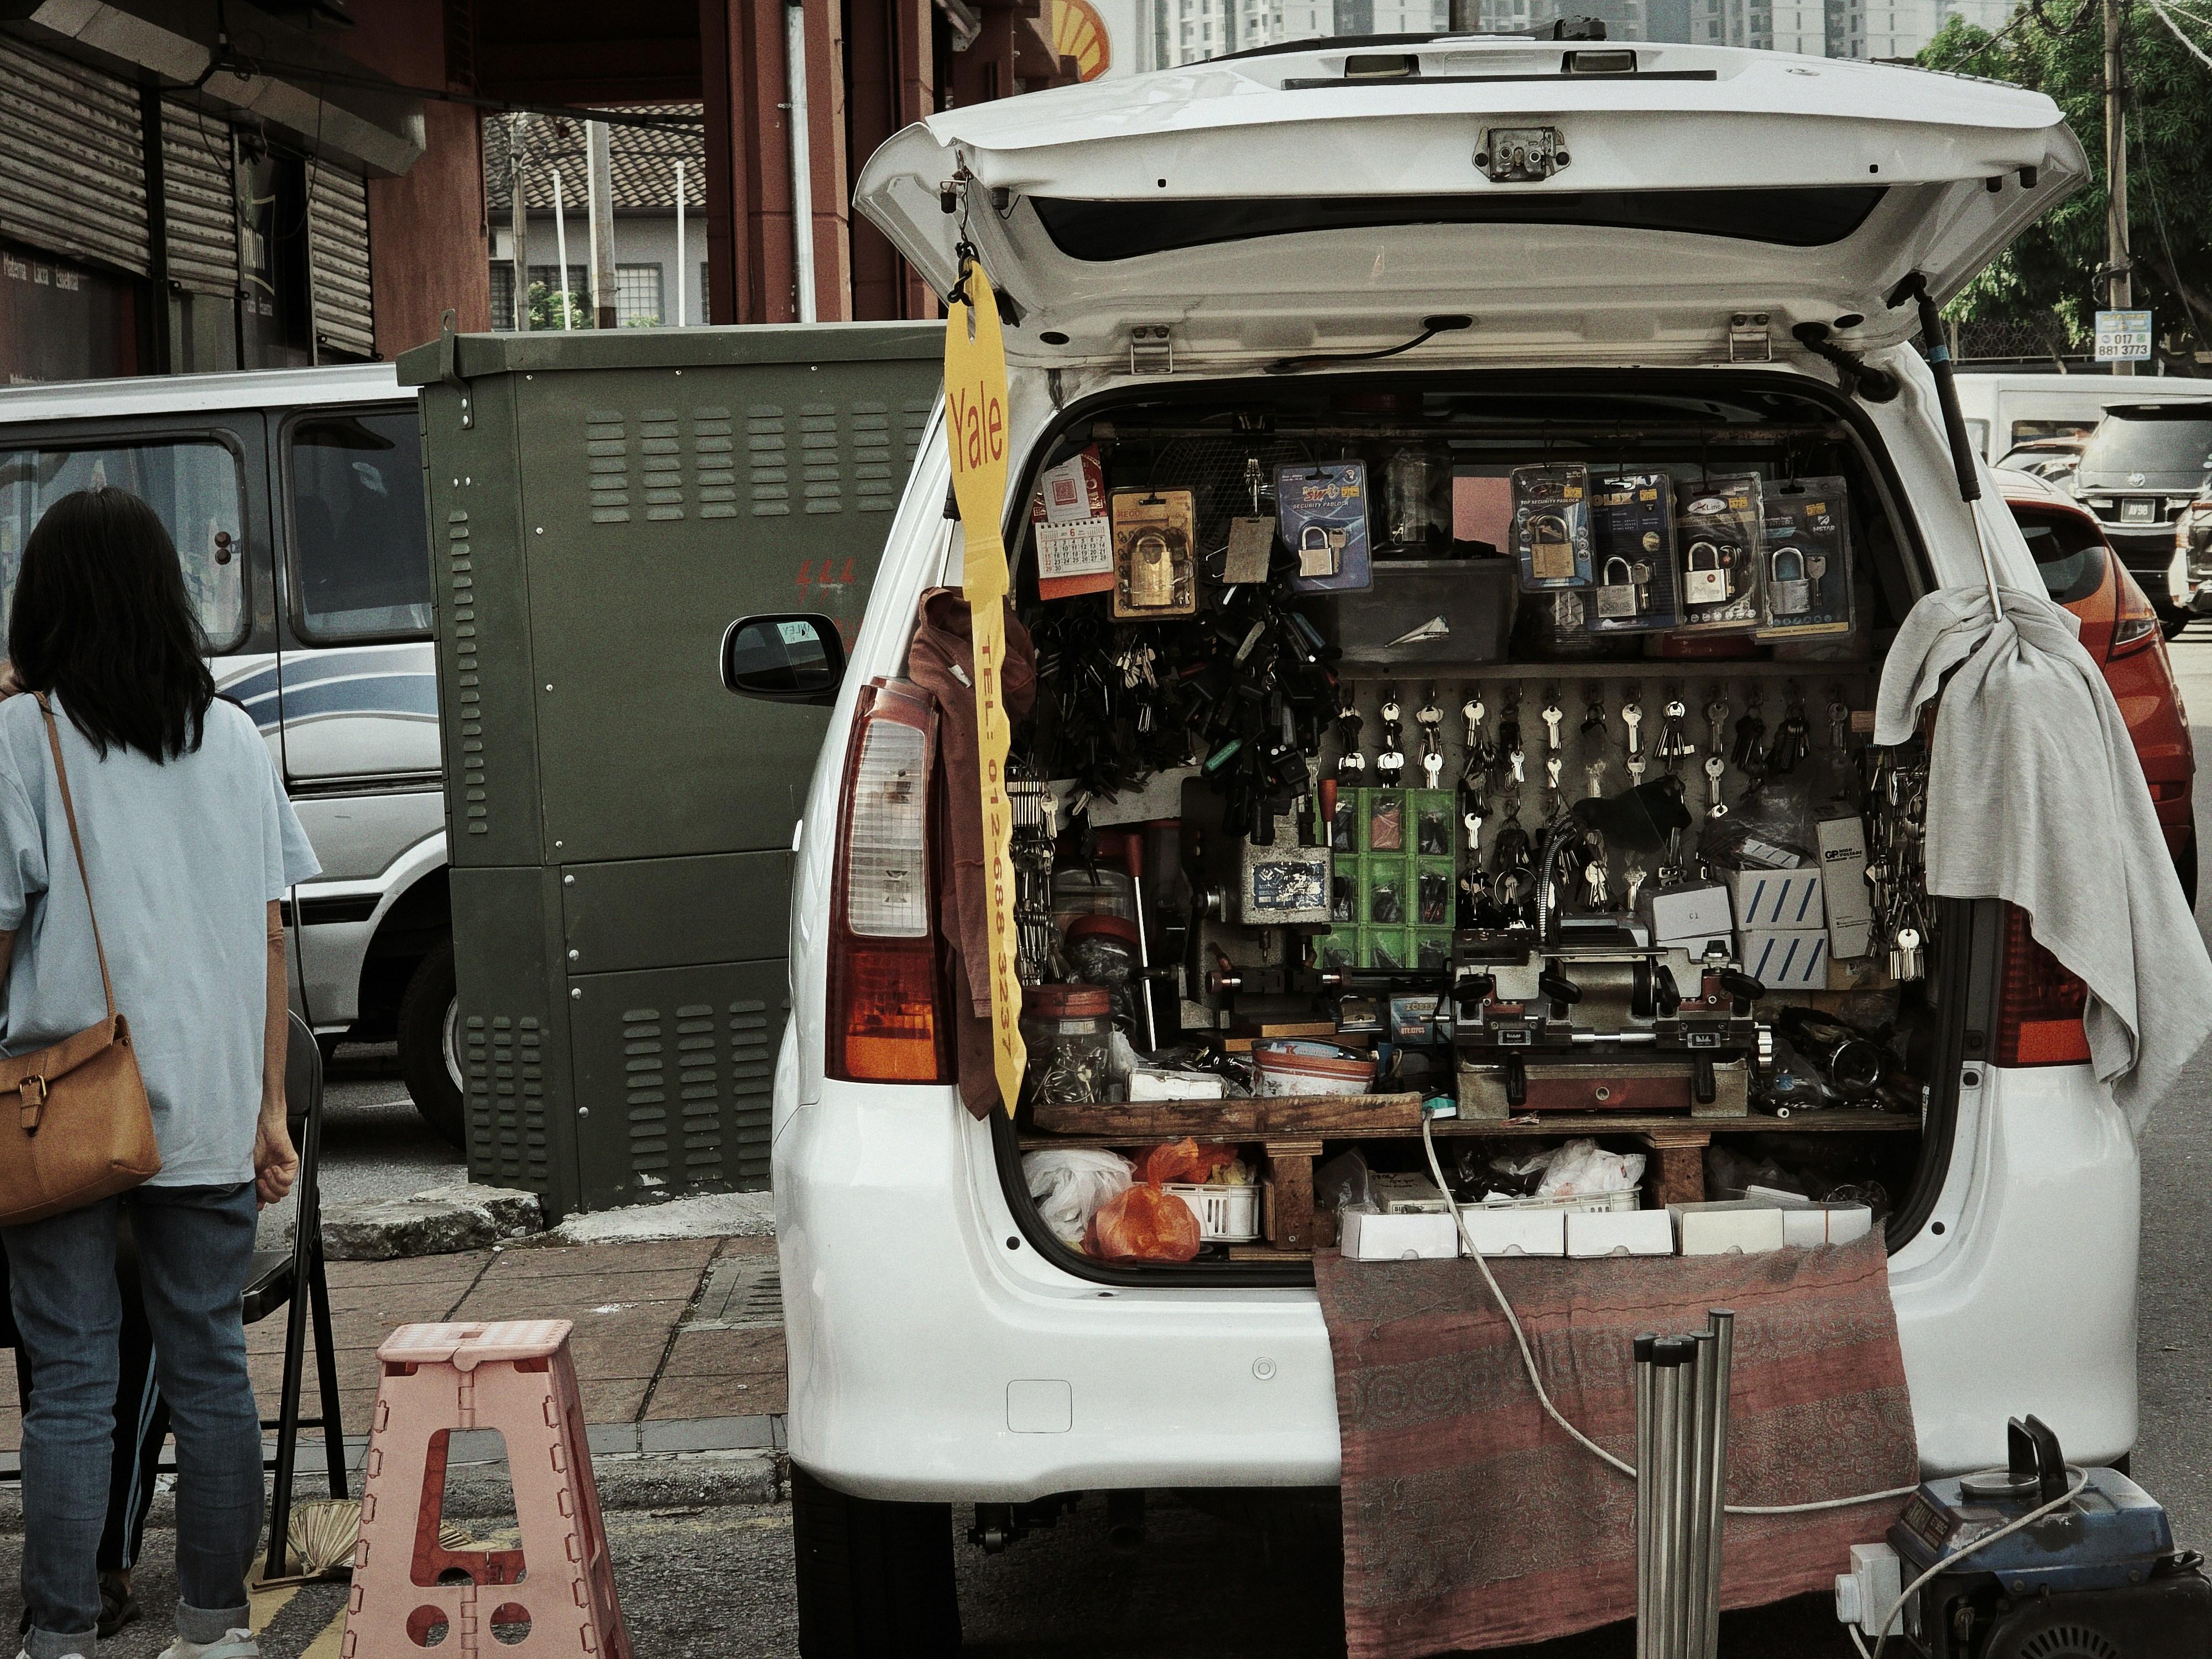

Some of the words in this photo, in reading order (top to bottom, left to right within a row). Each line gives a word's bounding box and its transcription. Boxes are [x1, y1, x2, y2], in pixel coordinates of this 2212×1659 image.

[2115, 335, 2132, 344] 017
[2099, 346, 2118, 356] 881
[2121, 345, 2147, 355] 3773
[950, 380, 1002, 473] Yale
[1070, 528, 1076, 537] 6
[982, 634, 994, 740] TEL:
[988, 758, 1005, 936] 012-688
[998, 951, 1011, 1059] 3237
[1825, 850, 1839, 859] GP
